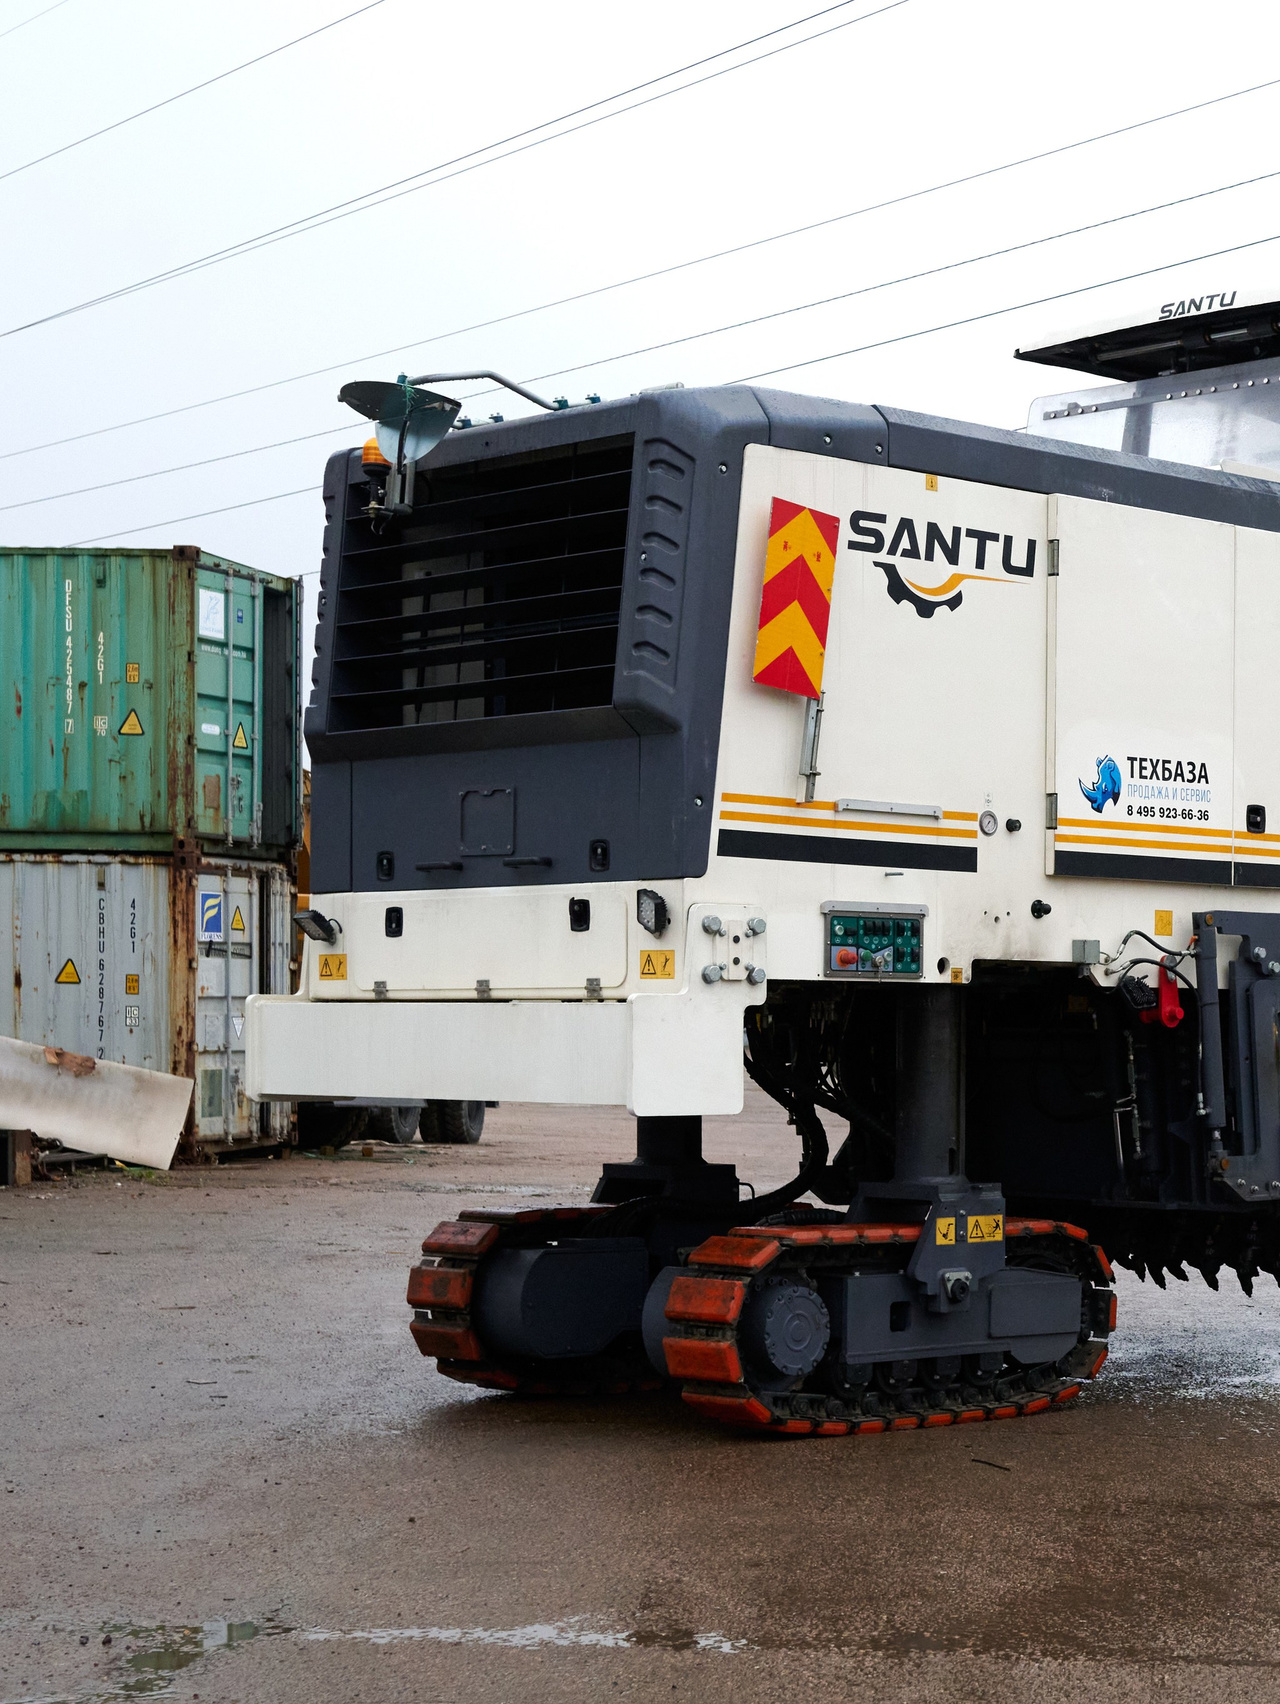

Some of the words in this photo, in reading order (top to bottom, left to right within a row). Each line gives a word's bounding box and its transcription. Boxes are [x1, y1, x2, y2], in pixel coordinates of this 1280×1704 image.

[1158, 291, 1237, 320] SANTU
[847, 510, 1036, 577] SANTU
[65, 635, 73, 714] 425487
[1127, 756, 1209, 784] ТЕХБАЗА
[1127, 784, 1169, 799] ПРОДАЖА
[1172, 787, 1177, 801] И
[1180, 787, 1211, 803] СЕРВИС
[1127, 804, 1133, 816] 8
[1136, 805, 1156, 818] 495
[1158, 806, 1210, 821] 923-66-36
